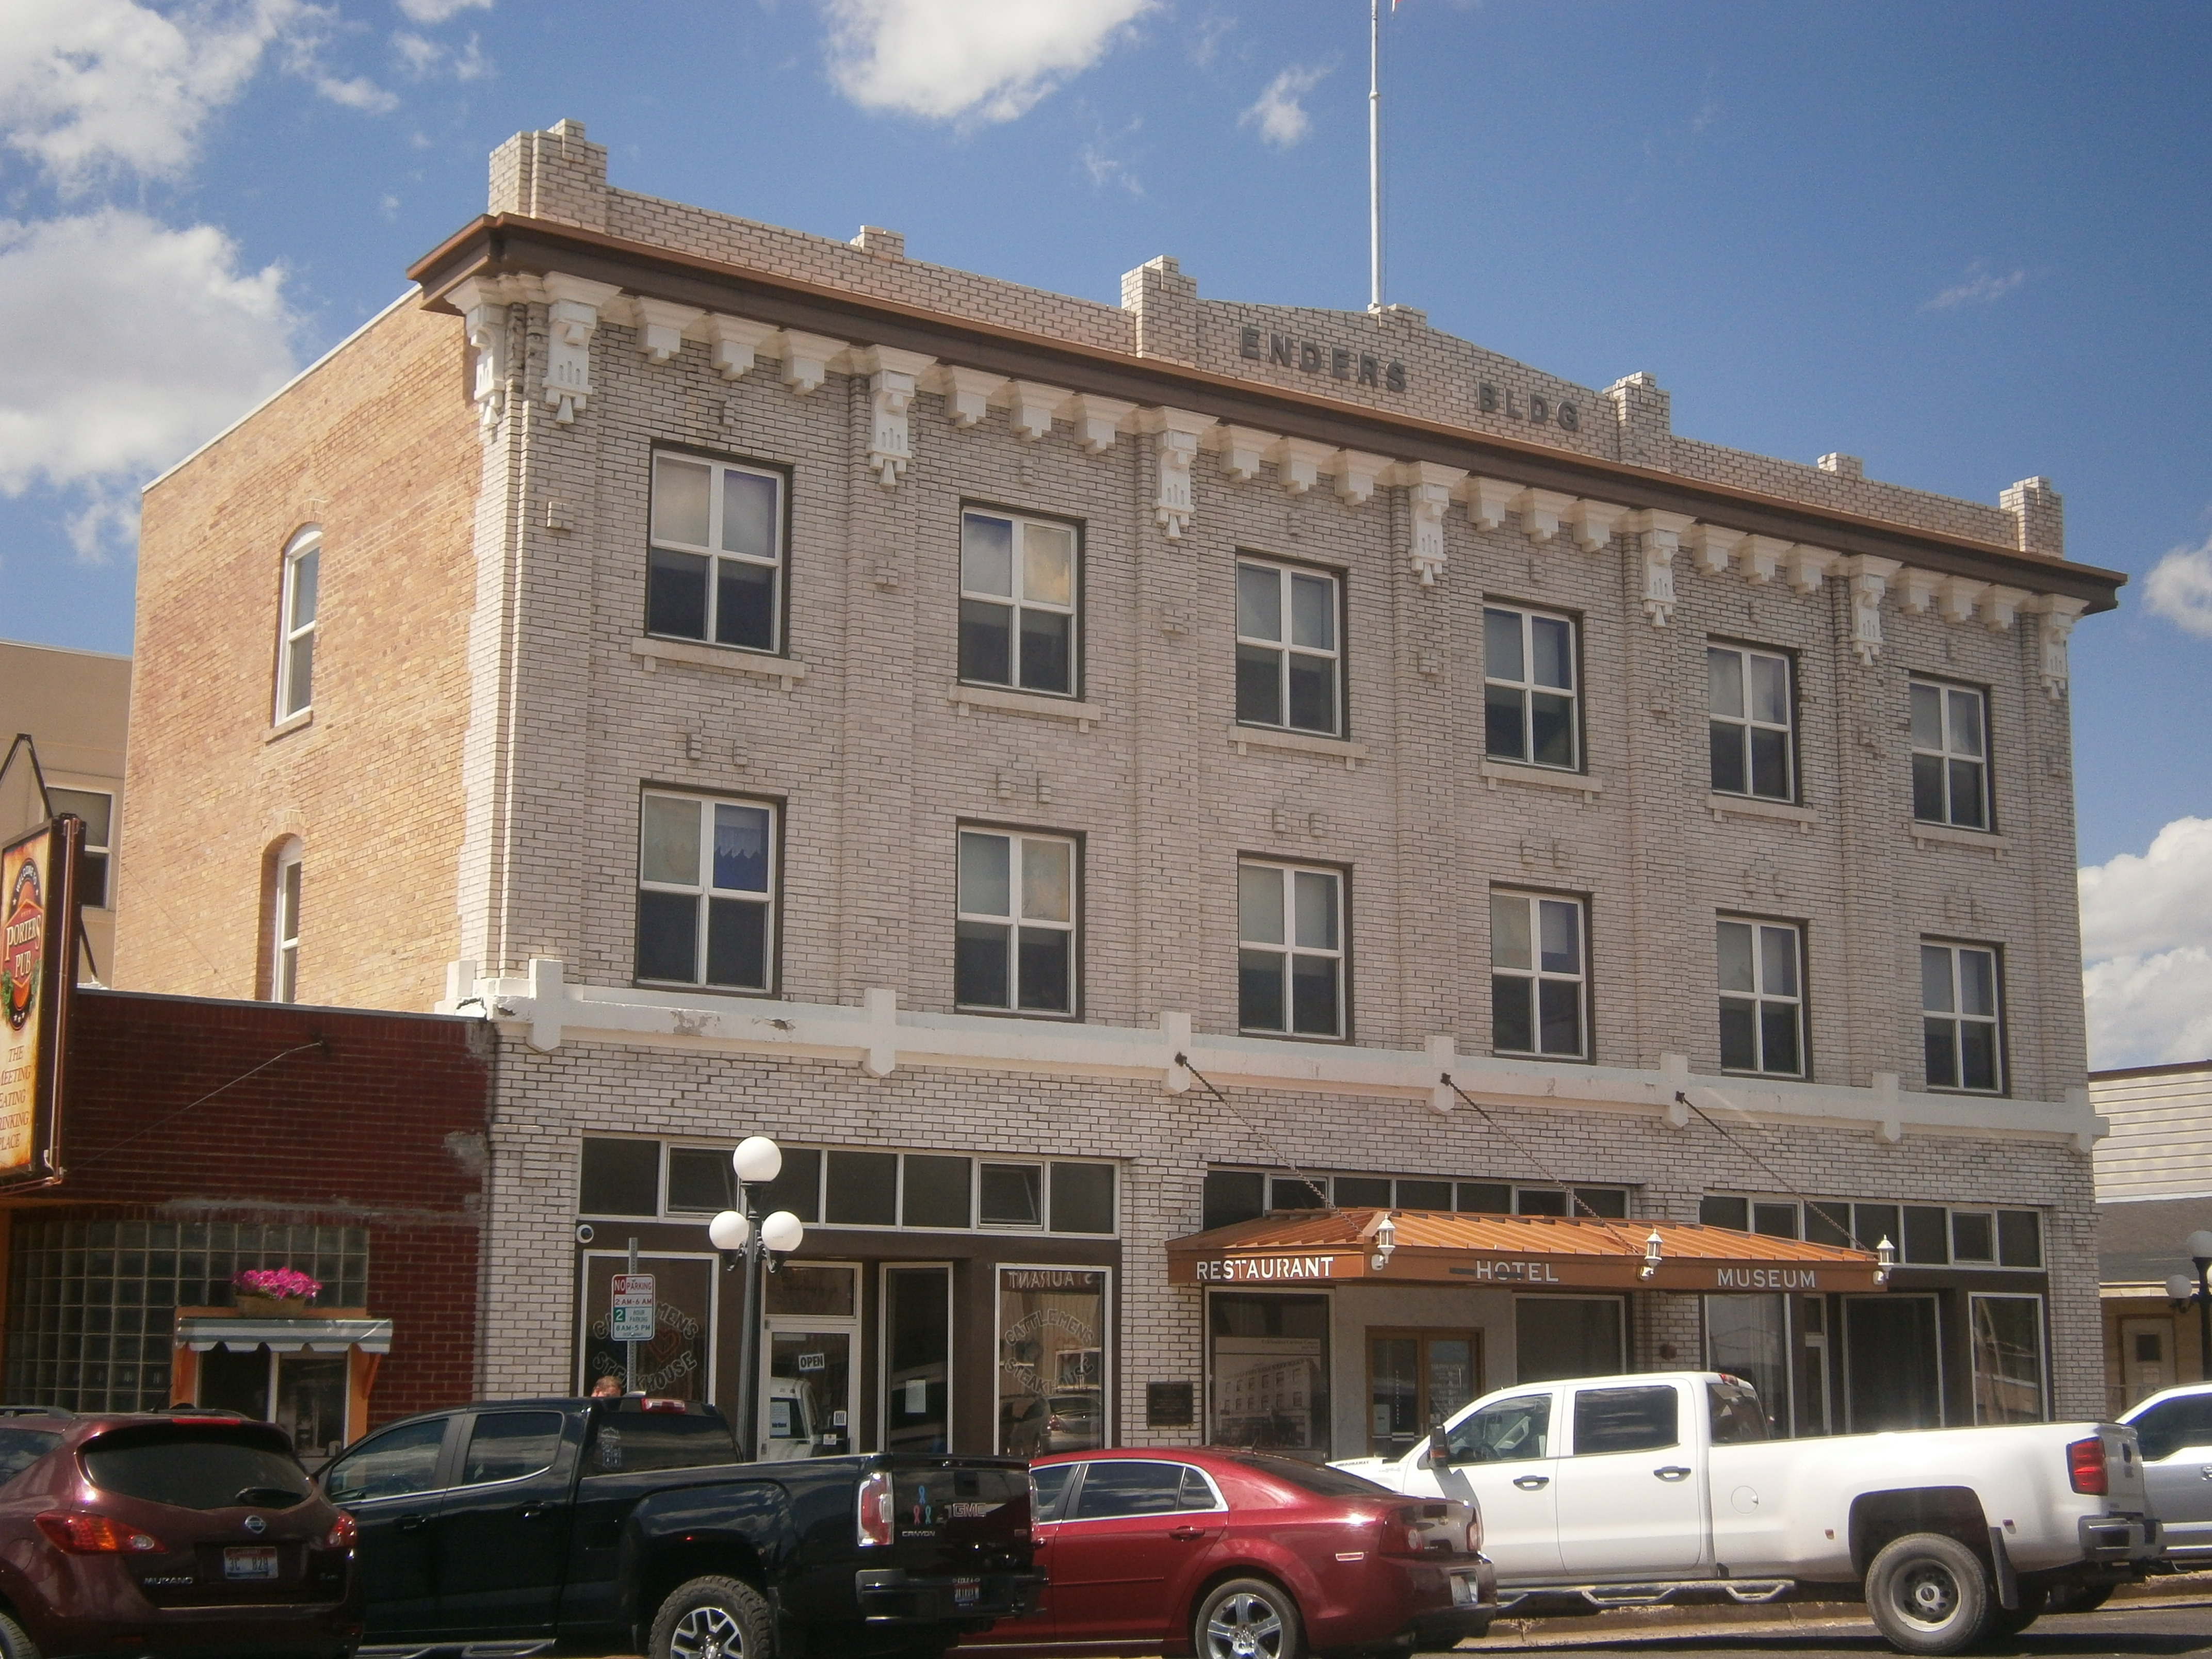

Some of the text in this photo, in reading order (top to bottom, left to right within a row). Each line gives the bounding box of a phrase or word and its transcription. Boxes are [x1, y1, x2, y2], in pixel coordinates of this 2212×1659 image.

[1240, 326, 1580, 431] ENDERS BLDG
[16, 865, 34, 892] WELCOME
[5, 914, 41, 962] PORTERS
[15, 950, 31, 978] PUB
[8, 1045, 24, 1063] THE
[1196, 1256, 1334, 1280] RESTAURANT
[1476, 1260, 1559, 1282] HOTEL
[1717, 1268, 1816, 1288] MUSEUM
[614, 1279, 652, 1291] NO PARKING
[593, 1301, 698, 1340] CMEN'S
[615, 1309, 624, 1321] 2
[593, 1351, 697, 1392] STEKHOUSE
[800, 1355, 823, 1368] OPEN
[1005, 1357, 1094, 1396] STEAKHOUSE
[953, 1503, 987, 1517] GMC
[144, 1576, 193, 1585] MURANO
